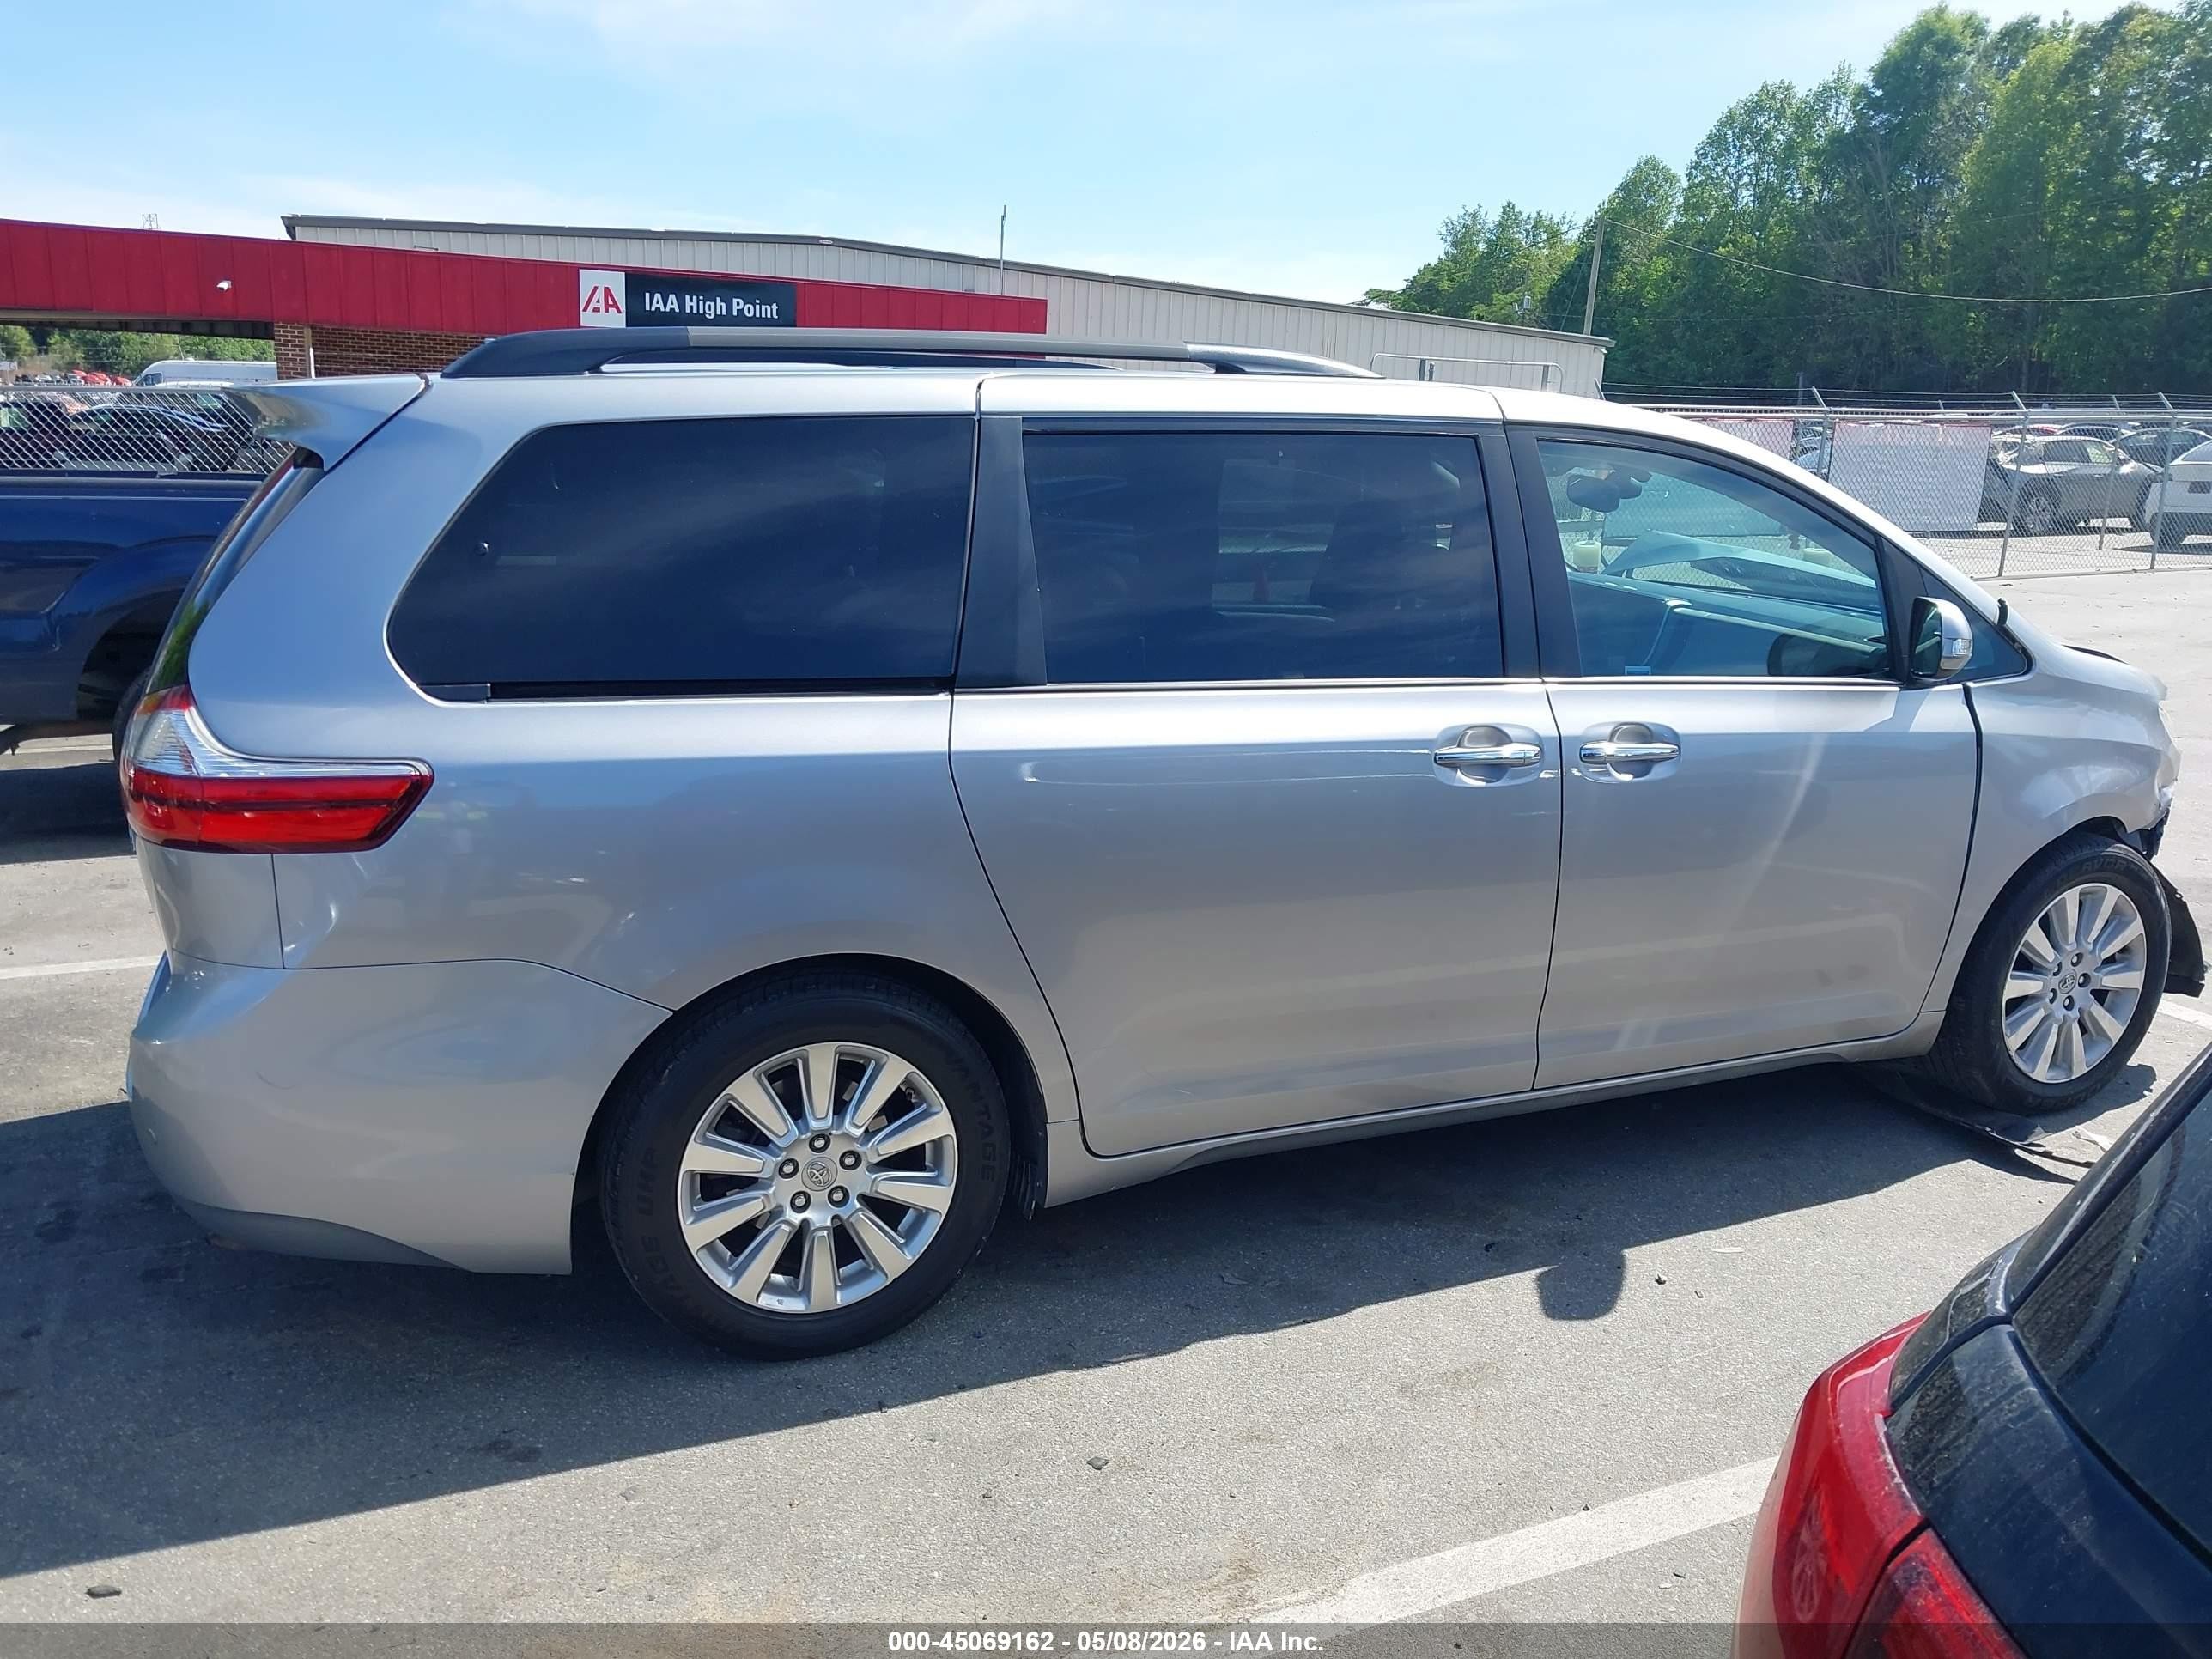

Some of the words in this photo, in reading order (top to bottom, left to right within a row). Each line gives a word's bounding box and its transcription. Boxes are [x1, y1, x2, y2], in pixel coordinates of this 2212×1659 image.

[645, 292, 679, 313] IAA
[685, 295, 726, 319] High
[732, 297, 779, 319] Point
